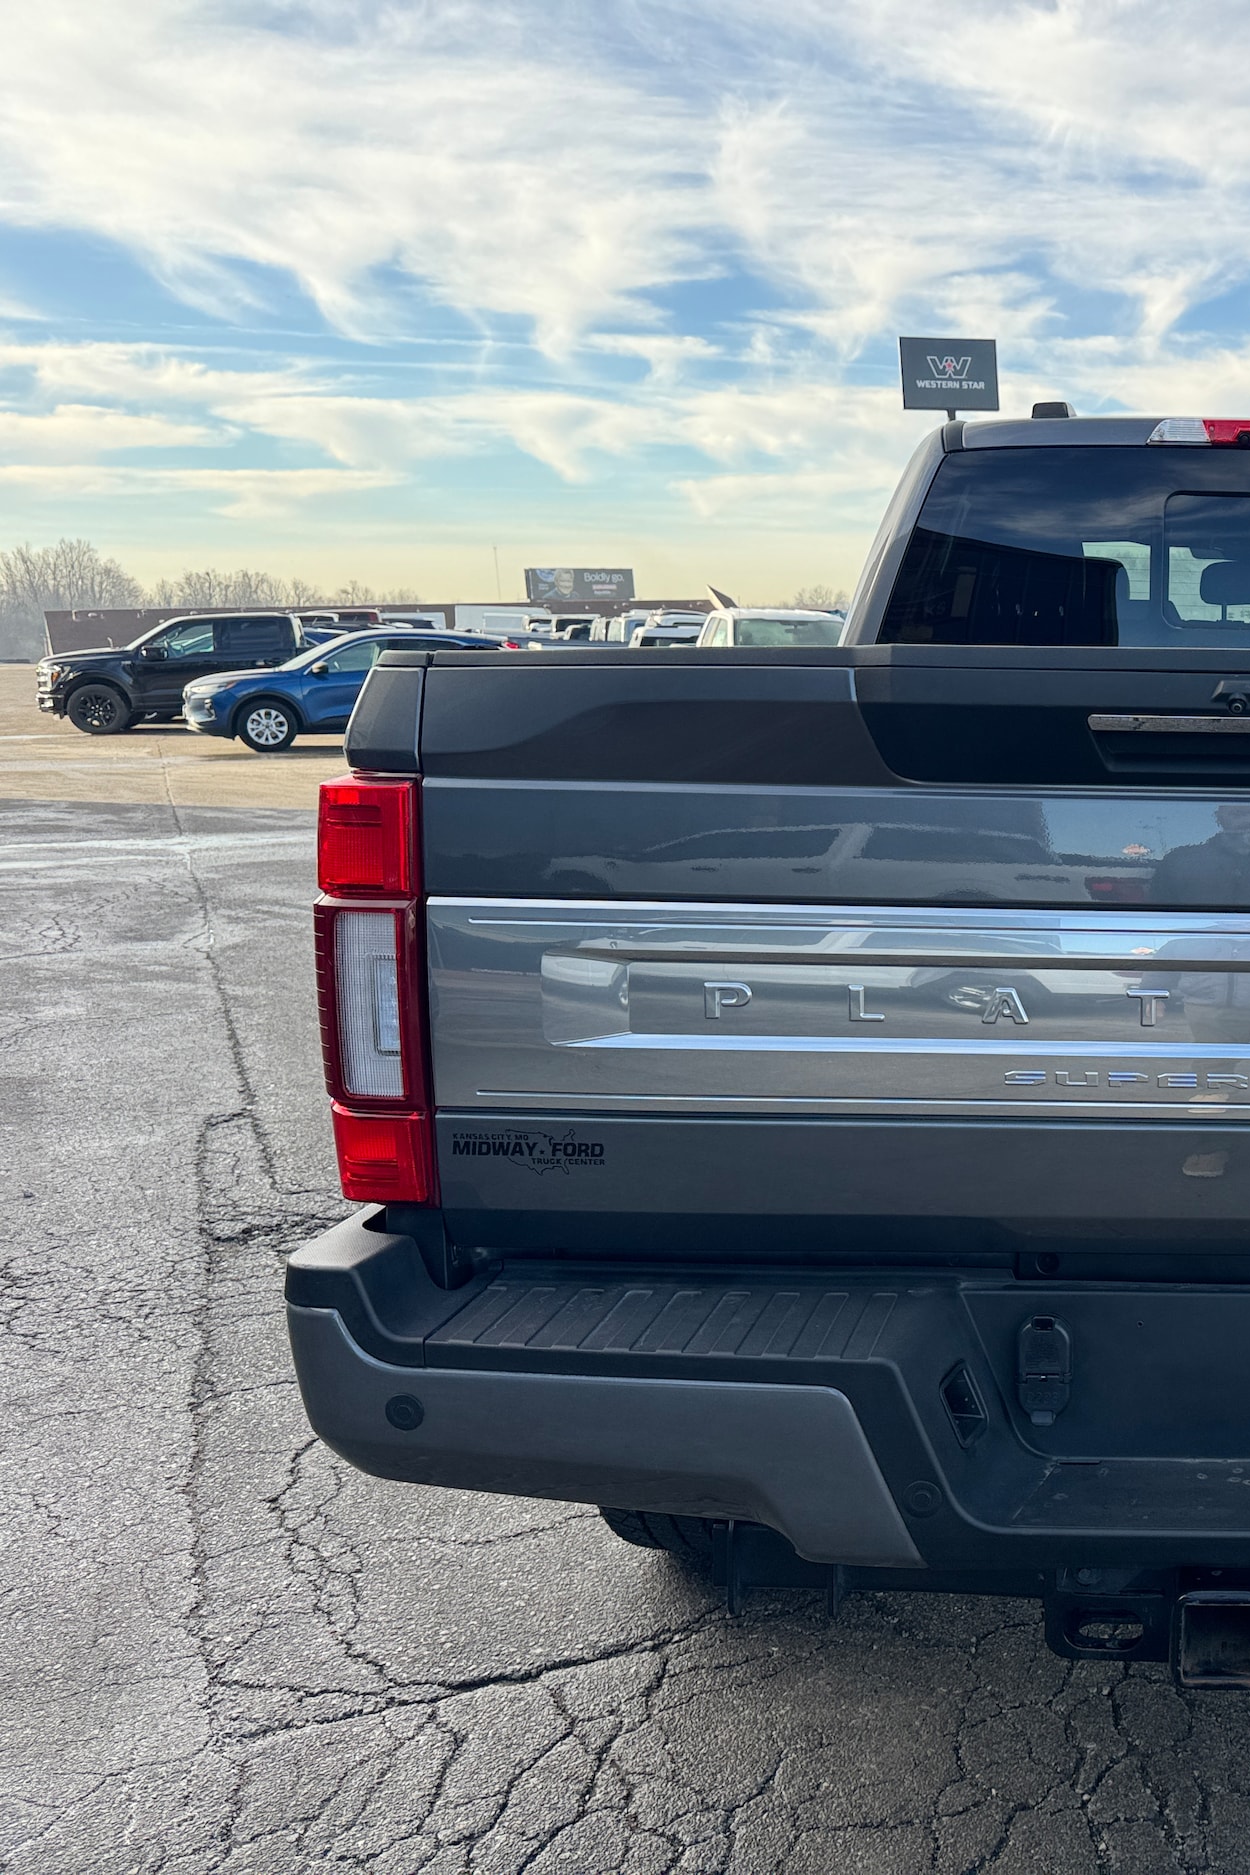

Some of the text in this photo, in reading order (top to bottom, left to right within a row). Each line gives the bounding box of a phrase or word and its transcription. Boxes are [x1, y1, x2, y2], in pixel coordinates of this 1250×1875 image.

[916, 379, 985, 390] WESTERN STAR
[583, 572, 610, 583] Boldly
[1004, 1069, 1249, 1090] SUPER
[452, 1133, 489, 1141] KANSAS
[514, 1133, 529, 1141] MO
[452, 1141, 605, 1158] MIDWAY FORD
[531, 1157, 605, 1166] TRUCK CENTER
